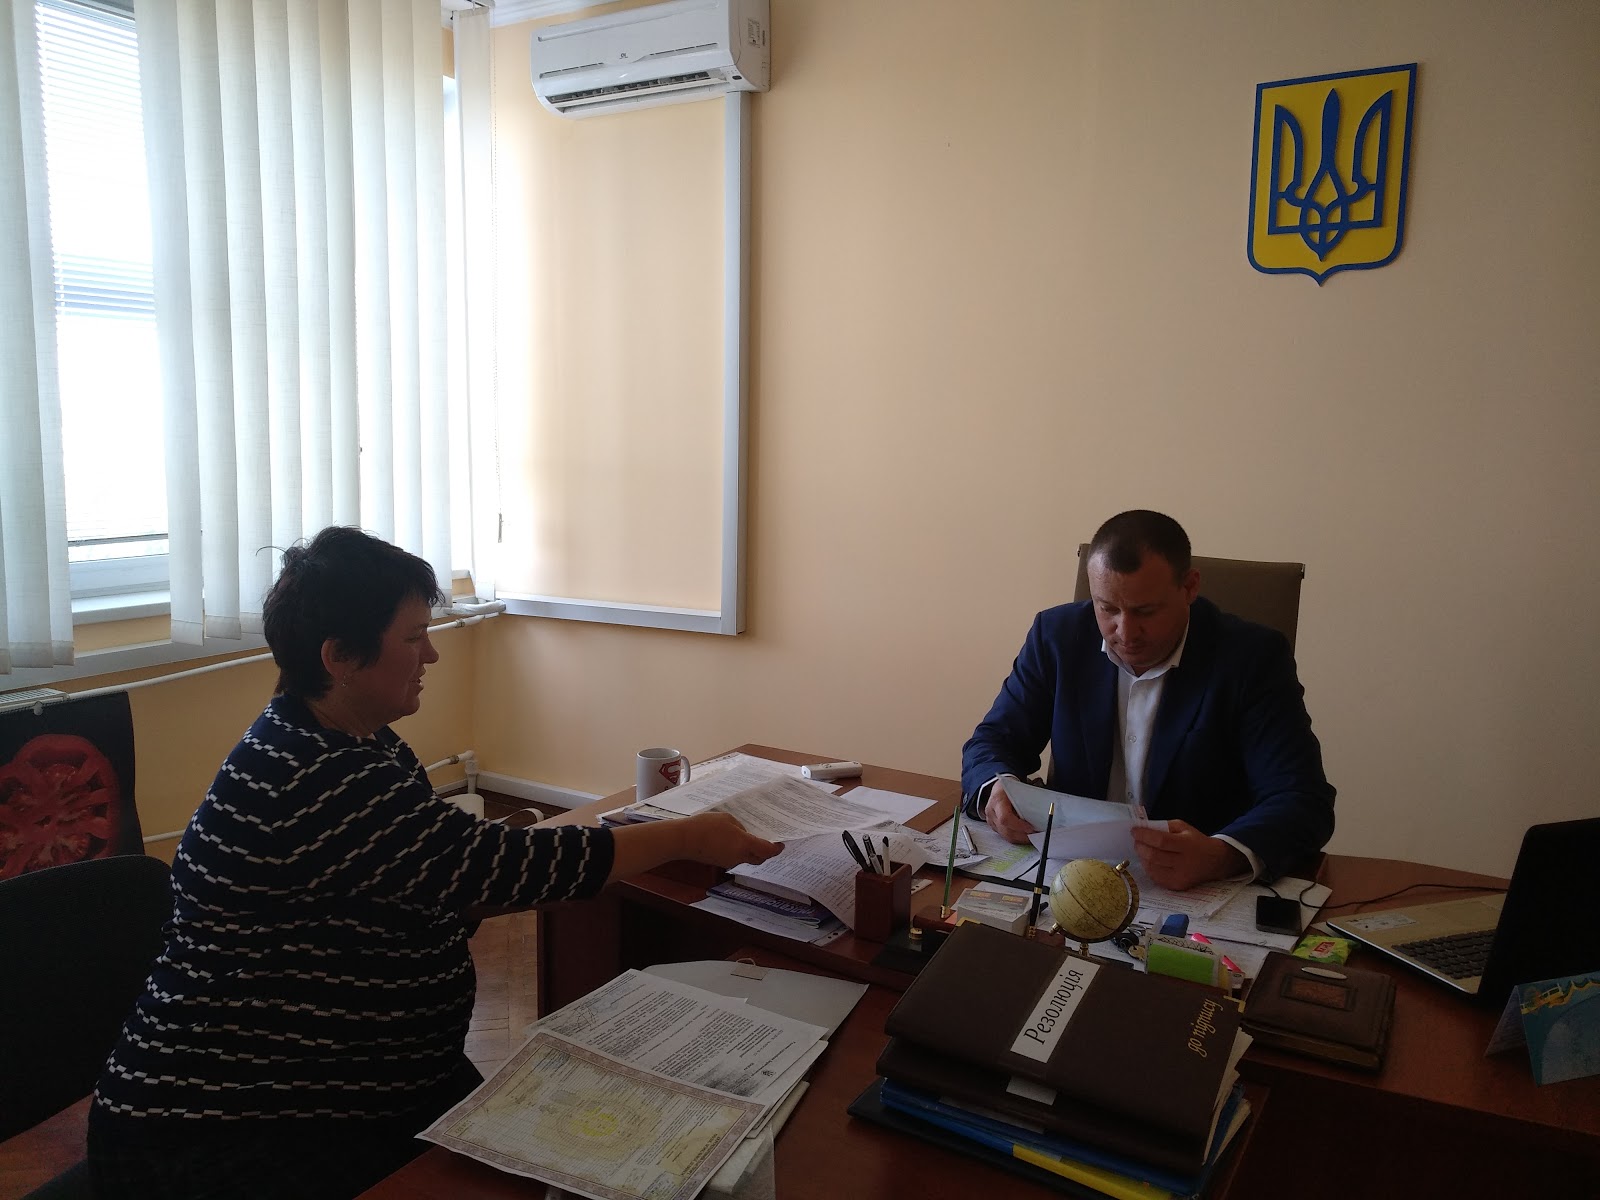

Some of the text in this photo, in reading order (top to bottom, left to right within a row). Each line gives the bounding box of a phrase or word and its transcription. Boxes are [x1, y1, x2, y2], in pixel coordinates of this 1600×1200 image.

[1023, 969, 1084, 1045] Резолюція
[1187, 998, 1224, 1058] до підпису
